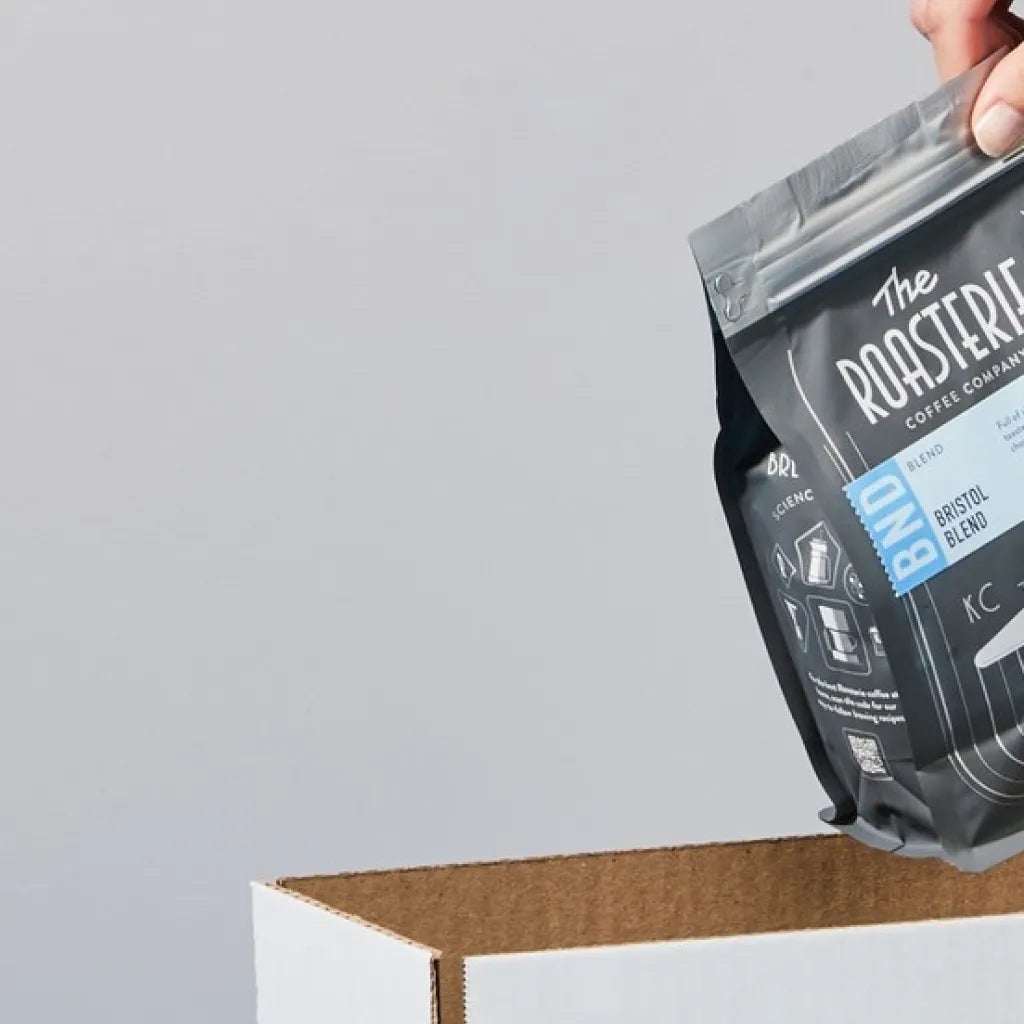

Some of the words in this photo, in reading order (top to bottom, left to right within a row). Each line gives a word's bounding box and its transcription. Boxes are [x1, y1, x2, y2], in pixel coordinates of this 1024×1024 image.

[872, 266, 939, 317] The
[905, 391, 961, 431] COFFEE
[907, 443, 944, 472] BLEND
[859, 473, 939, 580] BND
[933, 484, 990, 528] BRISTOL
[944, 510, 988, 548] BLEND
[962, 581, 1000, 624] KC
